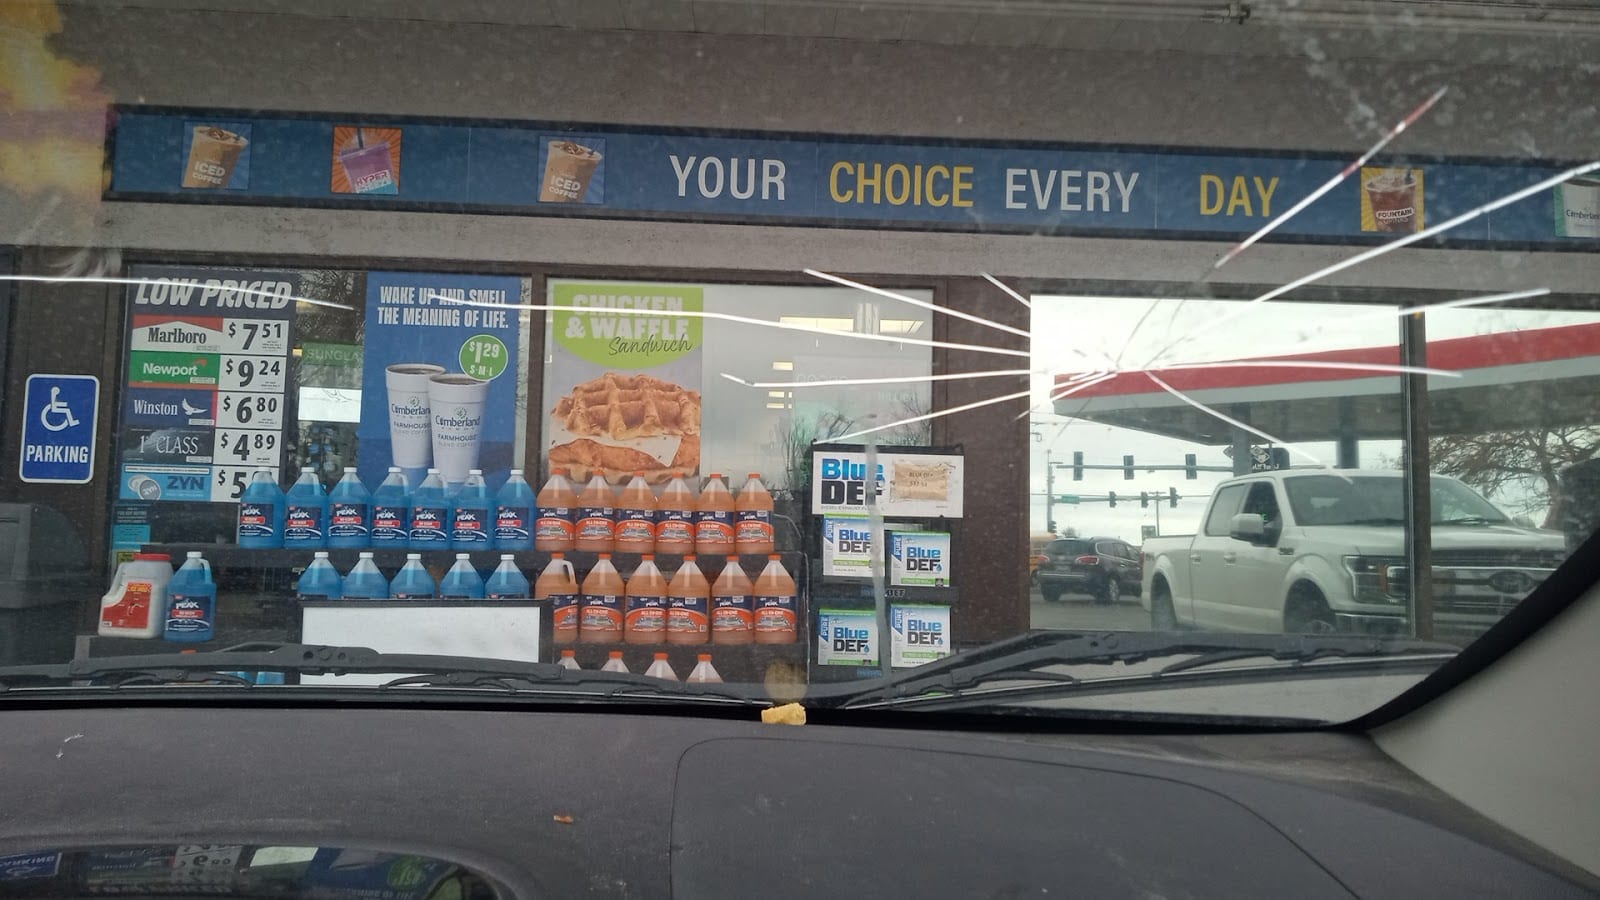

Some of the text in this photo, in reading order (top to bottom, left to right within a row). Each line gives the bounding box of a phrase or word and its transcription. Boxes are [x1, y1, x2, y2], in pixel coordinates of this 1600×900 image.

[194, 161, 226, 177] ICED
[356, 171, 388, 186] HYPER
[551, 175, 581, 191] ICED
[669, 155, 1280, 217] YOUR CHOICE EVERY DAY
[549, 186, 578, 199] COFFEE
[1378, 209, 1412, 218] FOUNTAIN
[135, 277, 292, 309] LOW PRICED
[380, 286, 415, 304] WAKE
[418, 287, 436, 305] UP
[439, 288, 464, 306] AND
[573, 294, 683, 317] CHICKEN
[377, 307, 509, 328] THE MEANING OF LIFE.
[147, 327, 207, 344] Marlboro
[565, 316, 689, 340] & WAFFLE
[608, 334, 692, 356] Sandwich
[143, 363, 198, 377] Newport
[134, 399, 178, 416] Winston
[392, 404, 431, 416] Cumberlan
[156, 436, 199, 454] CLASS
[26, 445, 89, 463] PARKING
[822, 458, 884, 481] Blue
[166, 475, 204, 490] ZYN
[821, 480, 883, 505] DEF
[839, 529, 871, 541] Blue
[839, 541, 871, 552] DEF
[906, 546, 941, 558] Blue
[906, 558, 941, 571] DEF
[176, 601, 199, 609] PEAK
[907, 619, 942, 631] Blue
[833, 627, 868, 639] Blue
[907, 632, 942, 645] DEF
[833, 640, 868, 652] DEF
